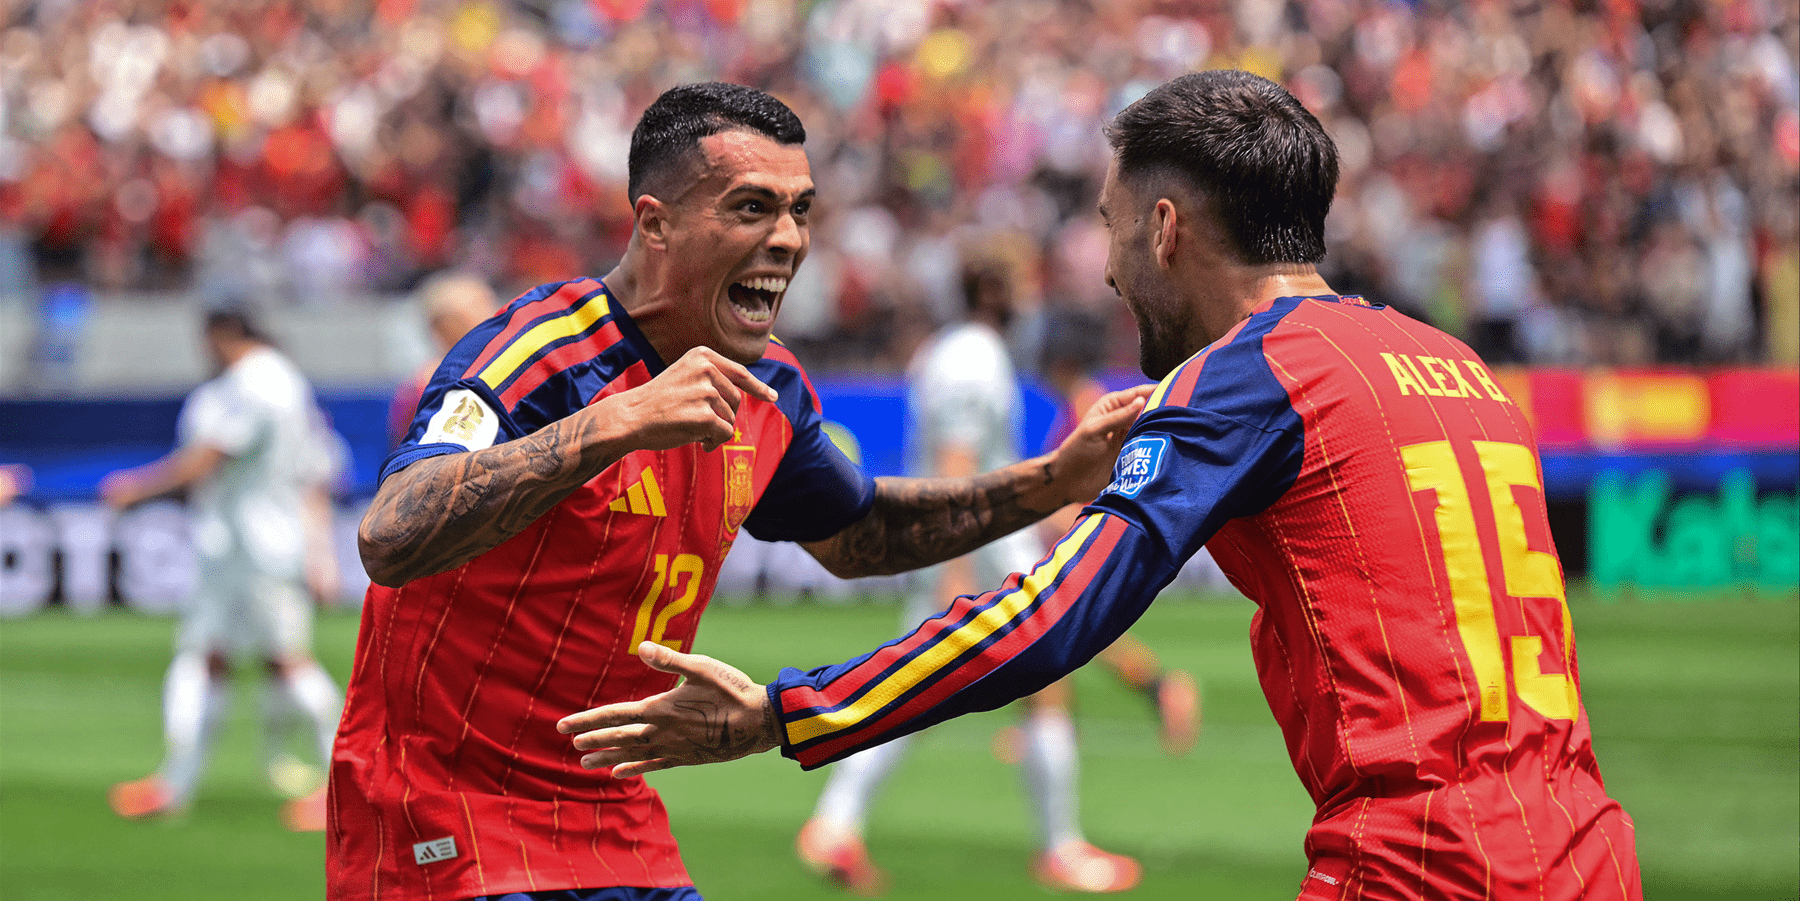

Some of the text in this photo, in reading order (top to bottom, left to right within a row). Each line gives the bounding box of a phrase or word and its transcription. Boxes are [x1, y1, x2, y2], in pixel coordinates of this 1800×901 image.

[1379, 352, 1483, 399] ALEX
[627, 553, 704, 655] 12
[1399, 439, 1579, 725] 15
